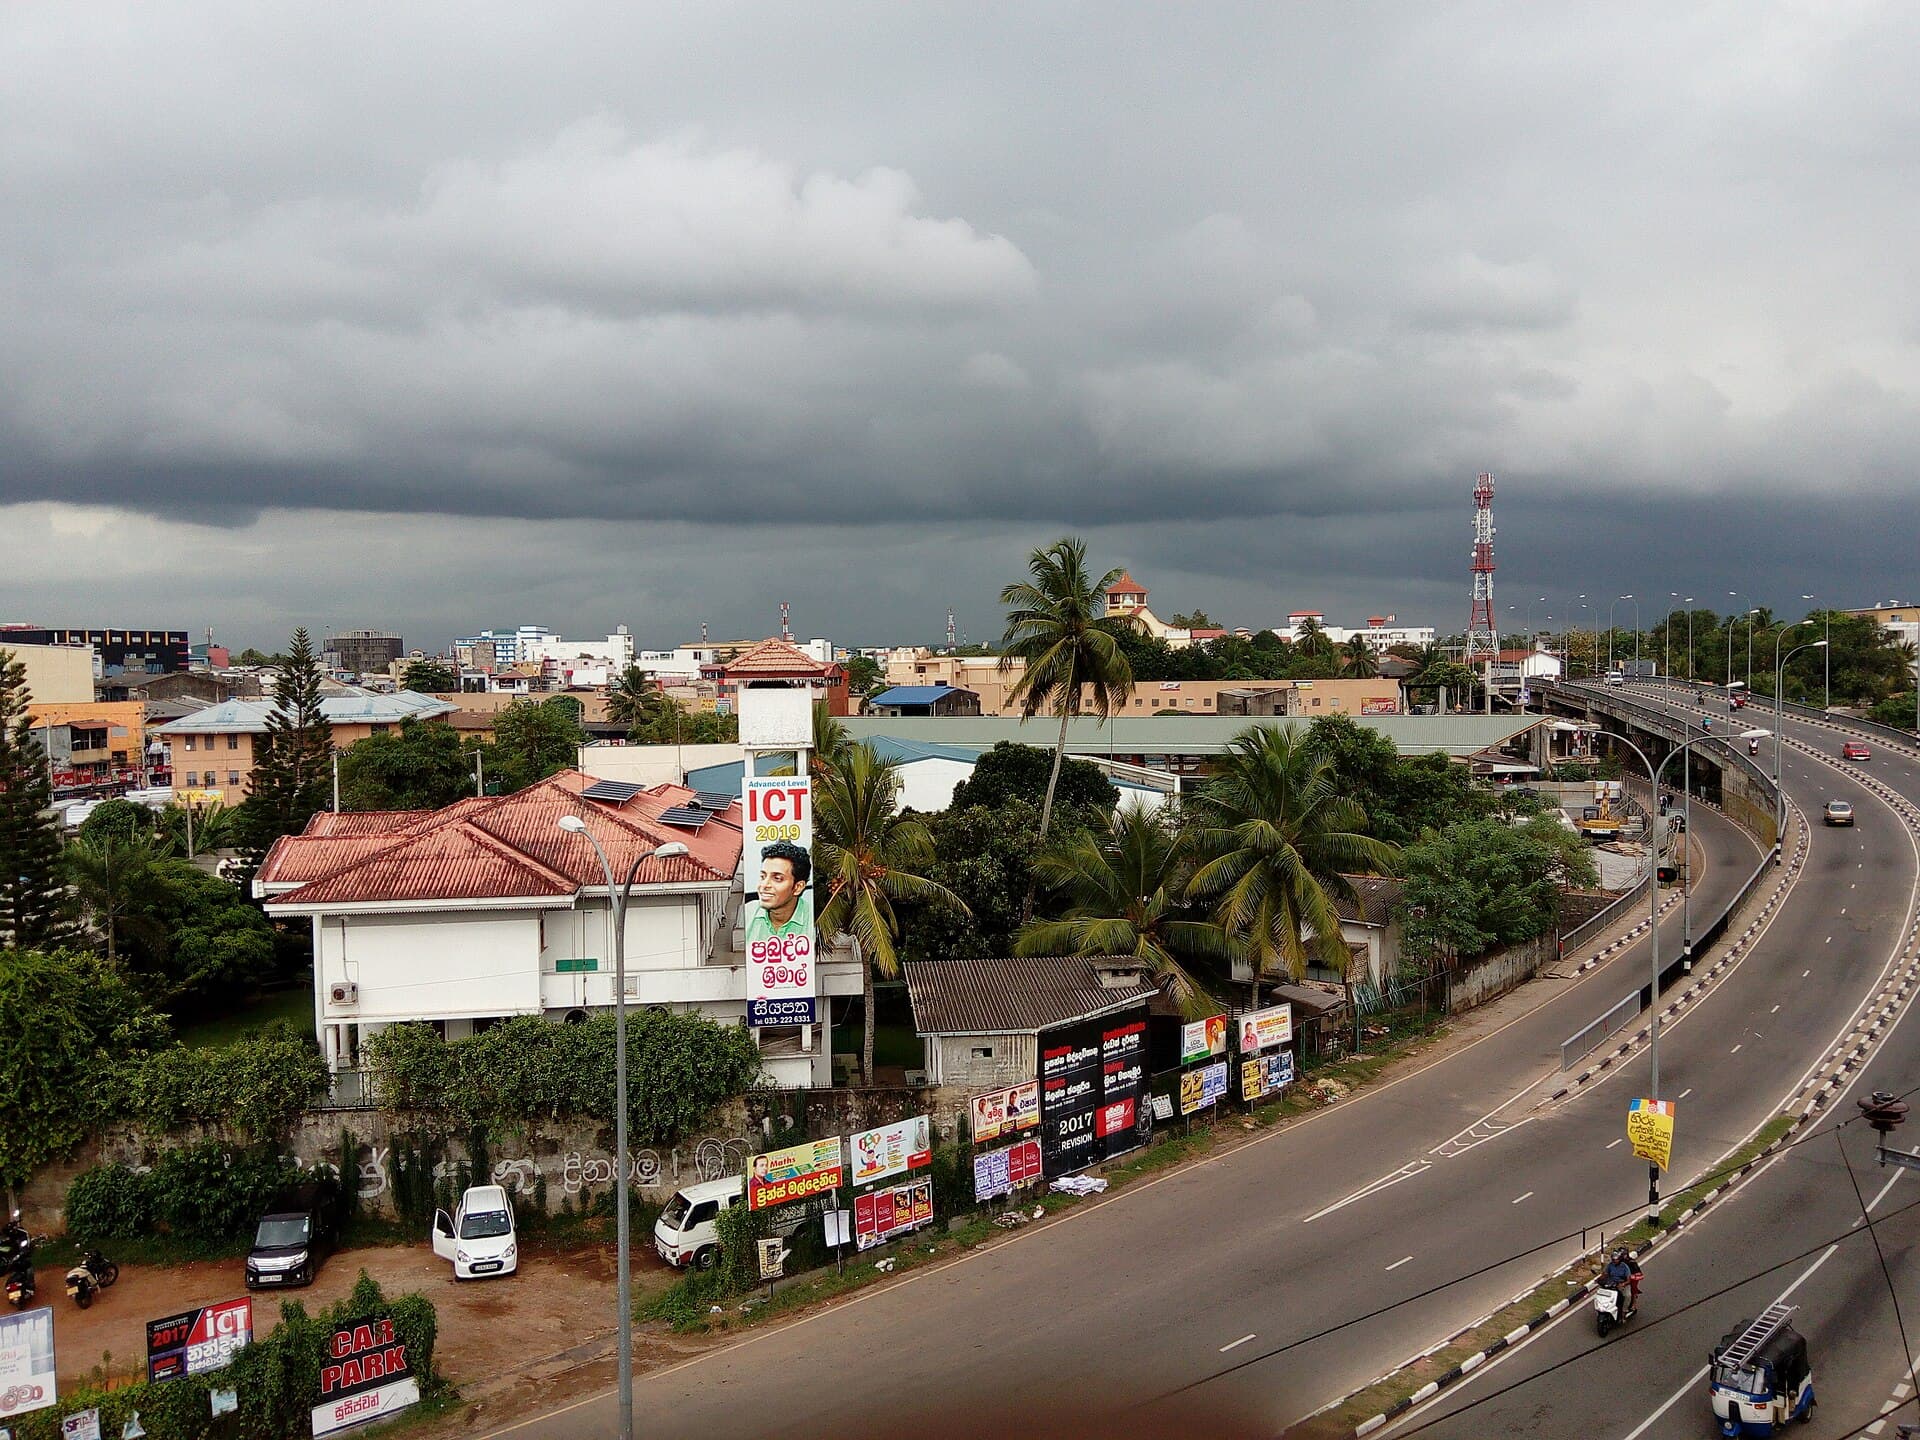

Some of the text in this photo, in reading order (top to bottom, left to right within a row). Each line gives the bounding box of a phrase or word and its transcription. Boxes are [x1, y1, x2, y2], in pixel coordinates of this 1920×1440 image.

[748, 779, 807, 788] Advanced Level
[749, 788, 808, 822] ICT
[756, 824, 800, 841] 2019
[780, 1016, 793, 1024] 222
[793, 1015, 811, 1023] 6331
[1059, 1112, 1093, 1135] 2017
[1061, 1132, 1093, 1150] REVISION
[769, 1156, 796, 1169] Maths
[152, 1325, 189, 1348] 2017
[329, 1319, 394, 1359] CAR
[321, 1345, 407, 1394] PARK
